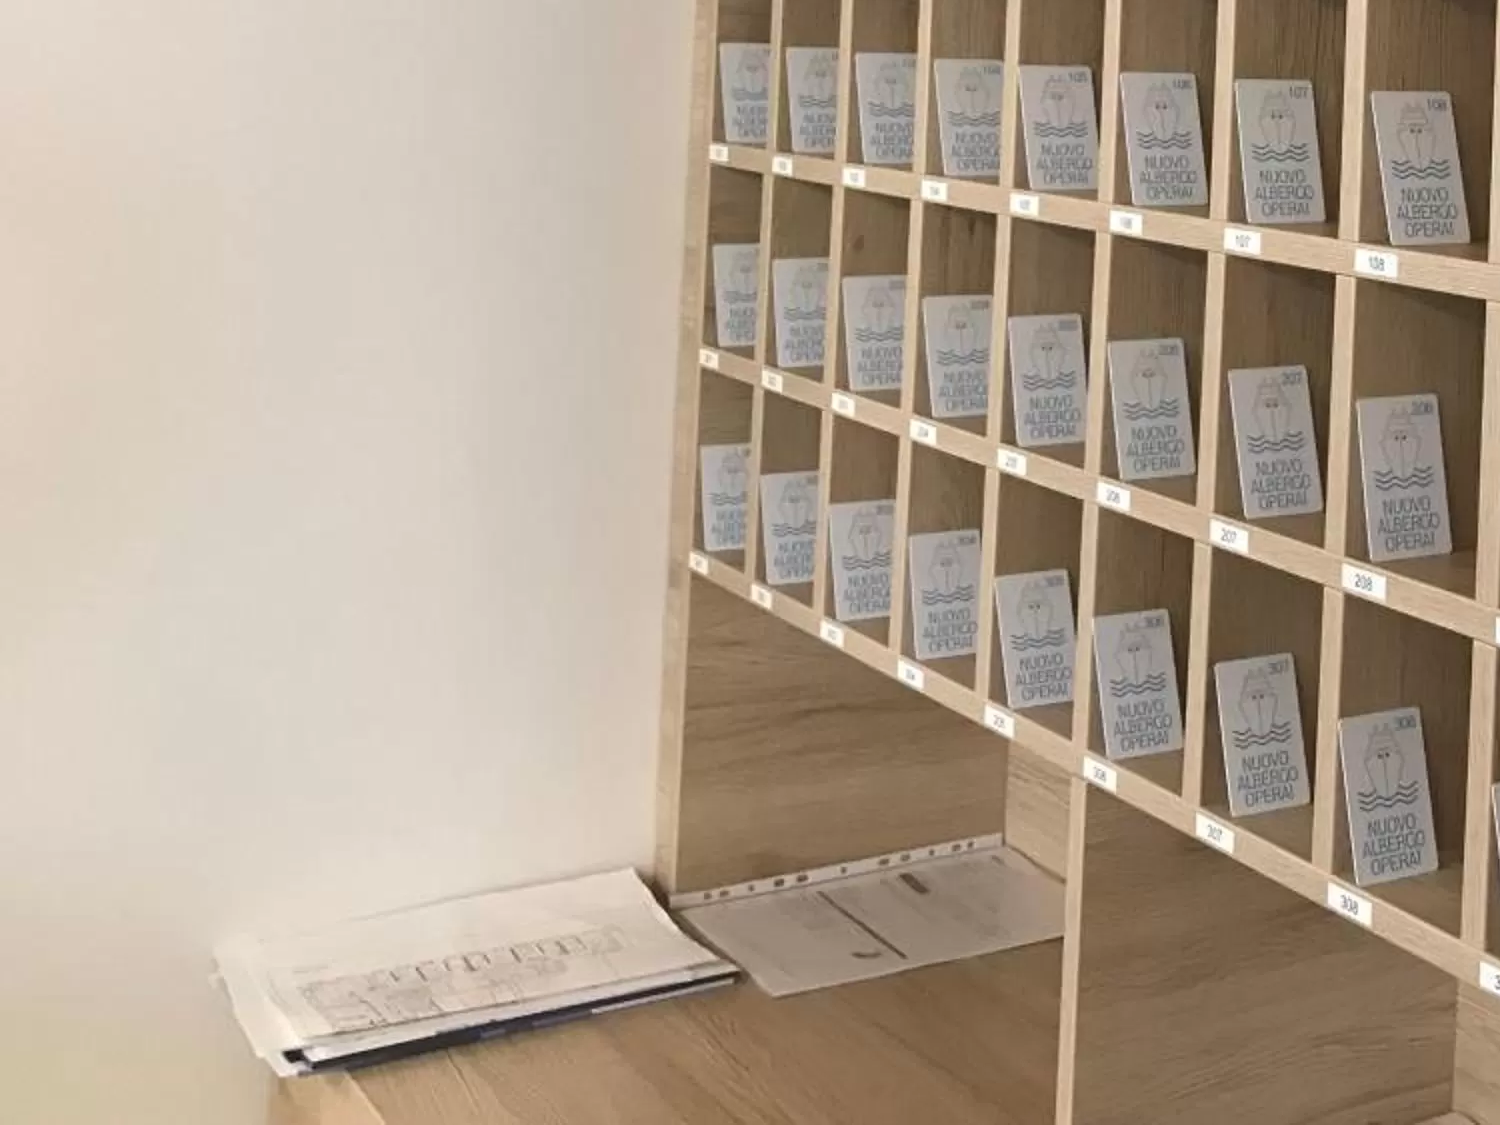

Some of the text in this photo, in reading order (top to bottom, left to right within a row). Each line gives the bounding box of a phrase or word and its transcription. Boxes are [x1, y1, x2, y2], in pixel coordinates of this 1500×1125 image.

[1260, 169, 1305, 184] NUOVO
[1255, 185, 1313, 200] ALBERGO
[1401, 187, 1449, 205] NUOVO
[1261, 201, 1310, 216] OPERAI
[1397, 205, 1457, 220] ALBERGO
[1405, 221, 1454, 237] OPERAI
[1256, 459, 1302, 476] NUOVO
[1251, 475, 1311, 494] ALBERGO
[1258, 491, 1307, 509] OPERAI
[1383, 495, 1431, 515] NUOVO
[1378, 514, 1440, 535] ALBERGO
[1386, 534, 1435, 553] OPERAI
[1355, 574, 1373, 591] 208
[1242, 750, 1288, 772] NUOVO
[1238, 766, 1298, 791] ALBERGO
[1245, 785, 1294, 807] OPERAI
[1367, 813, 1417, 837] NUOVO
[1362, 830, 1425, 858] ALBERGO
[1371, 851, 1422, 875] OPERAI
